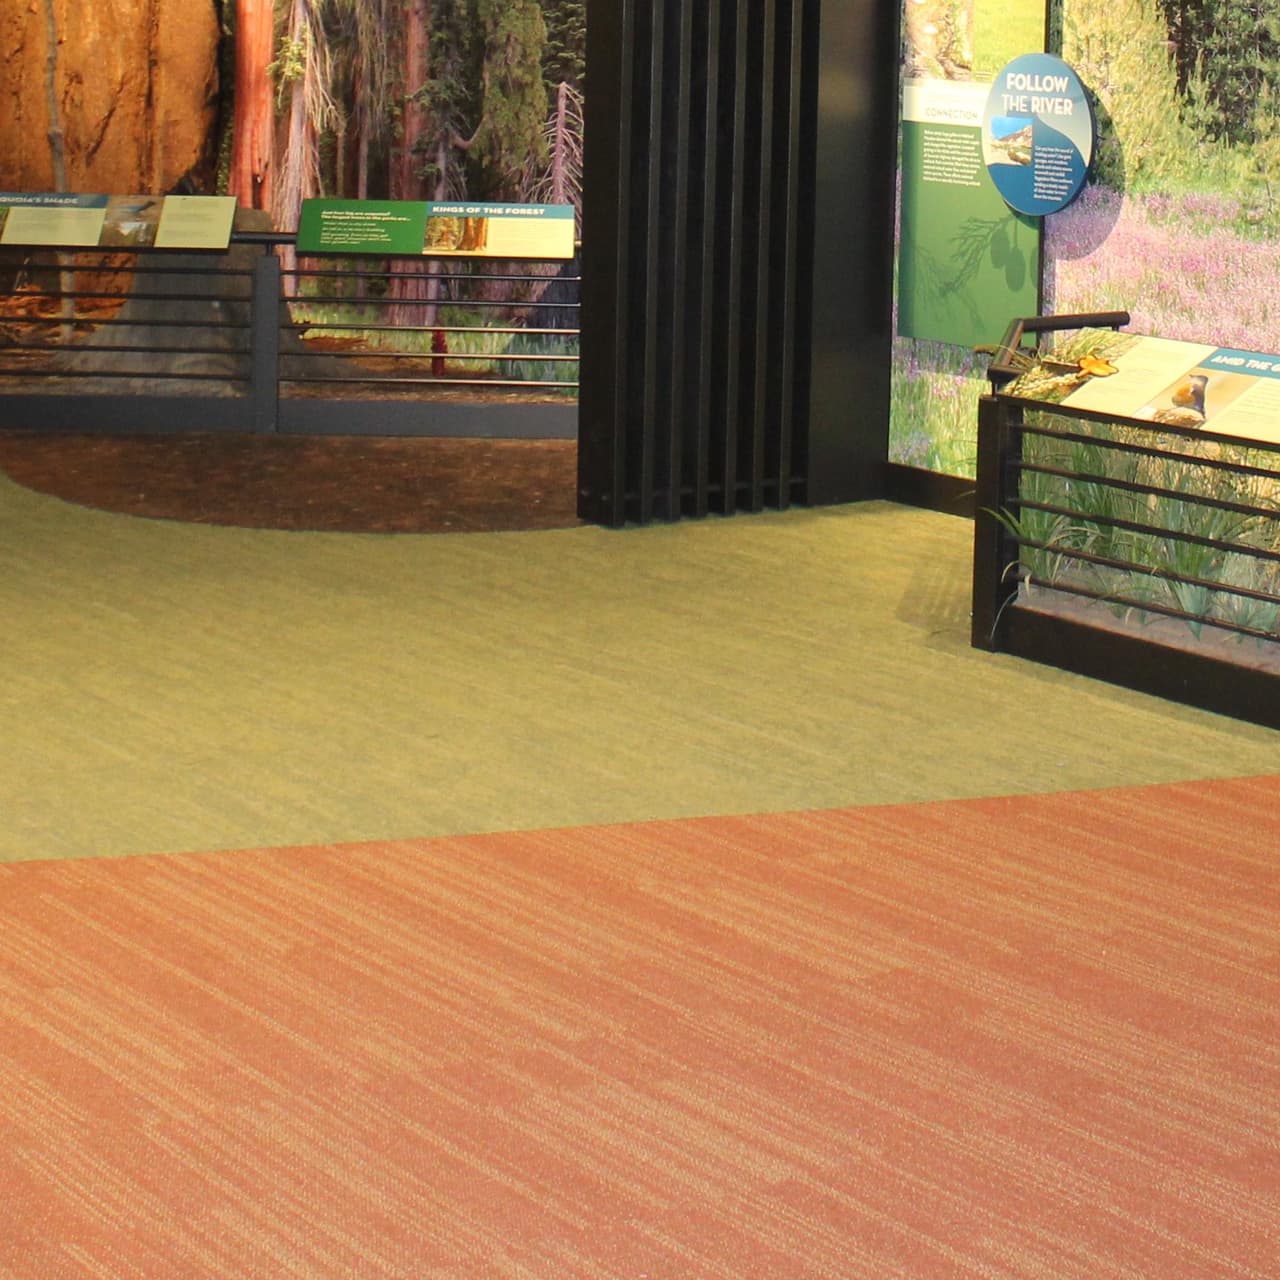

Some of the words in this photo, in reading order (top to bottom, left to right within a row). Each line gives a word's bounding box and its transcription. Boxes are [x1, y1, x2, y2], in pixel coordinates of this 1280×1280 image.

[1006, 73, 1069, 93] FOLLOW
[1001, 94, 1028, 113] THE
[1031, 96, 1073, 116] RIVER
[505, 207, 545, 215] FOREST
[1211, 355, 1246, 367] AMID
[1245, 359, 1273, 371] THE
